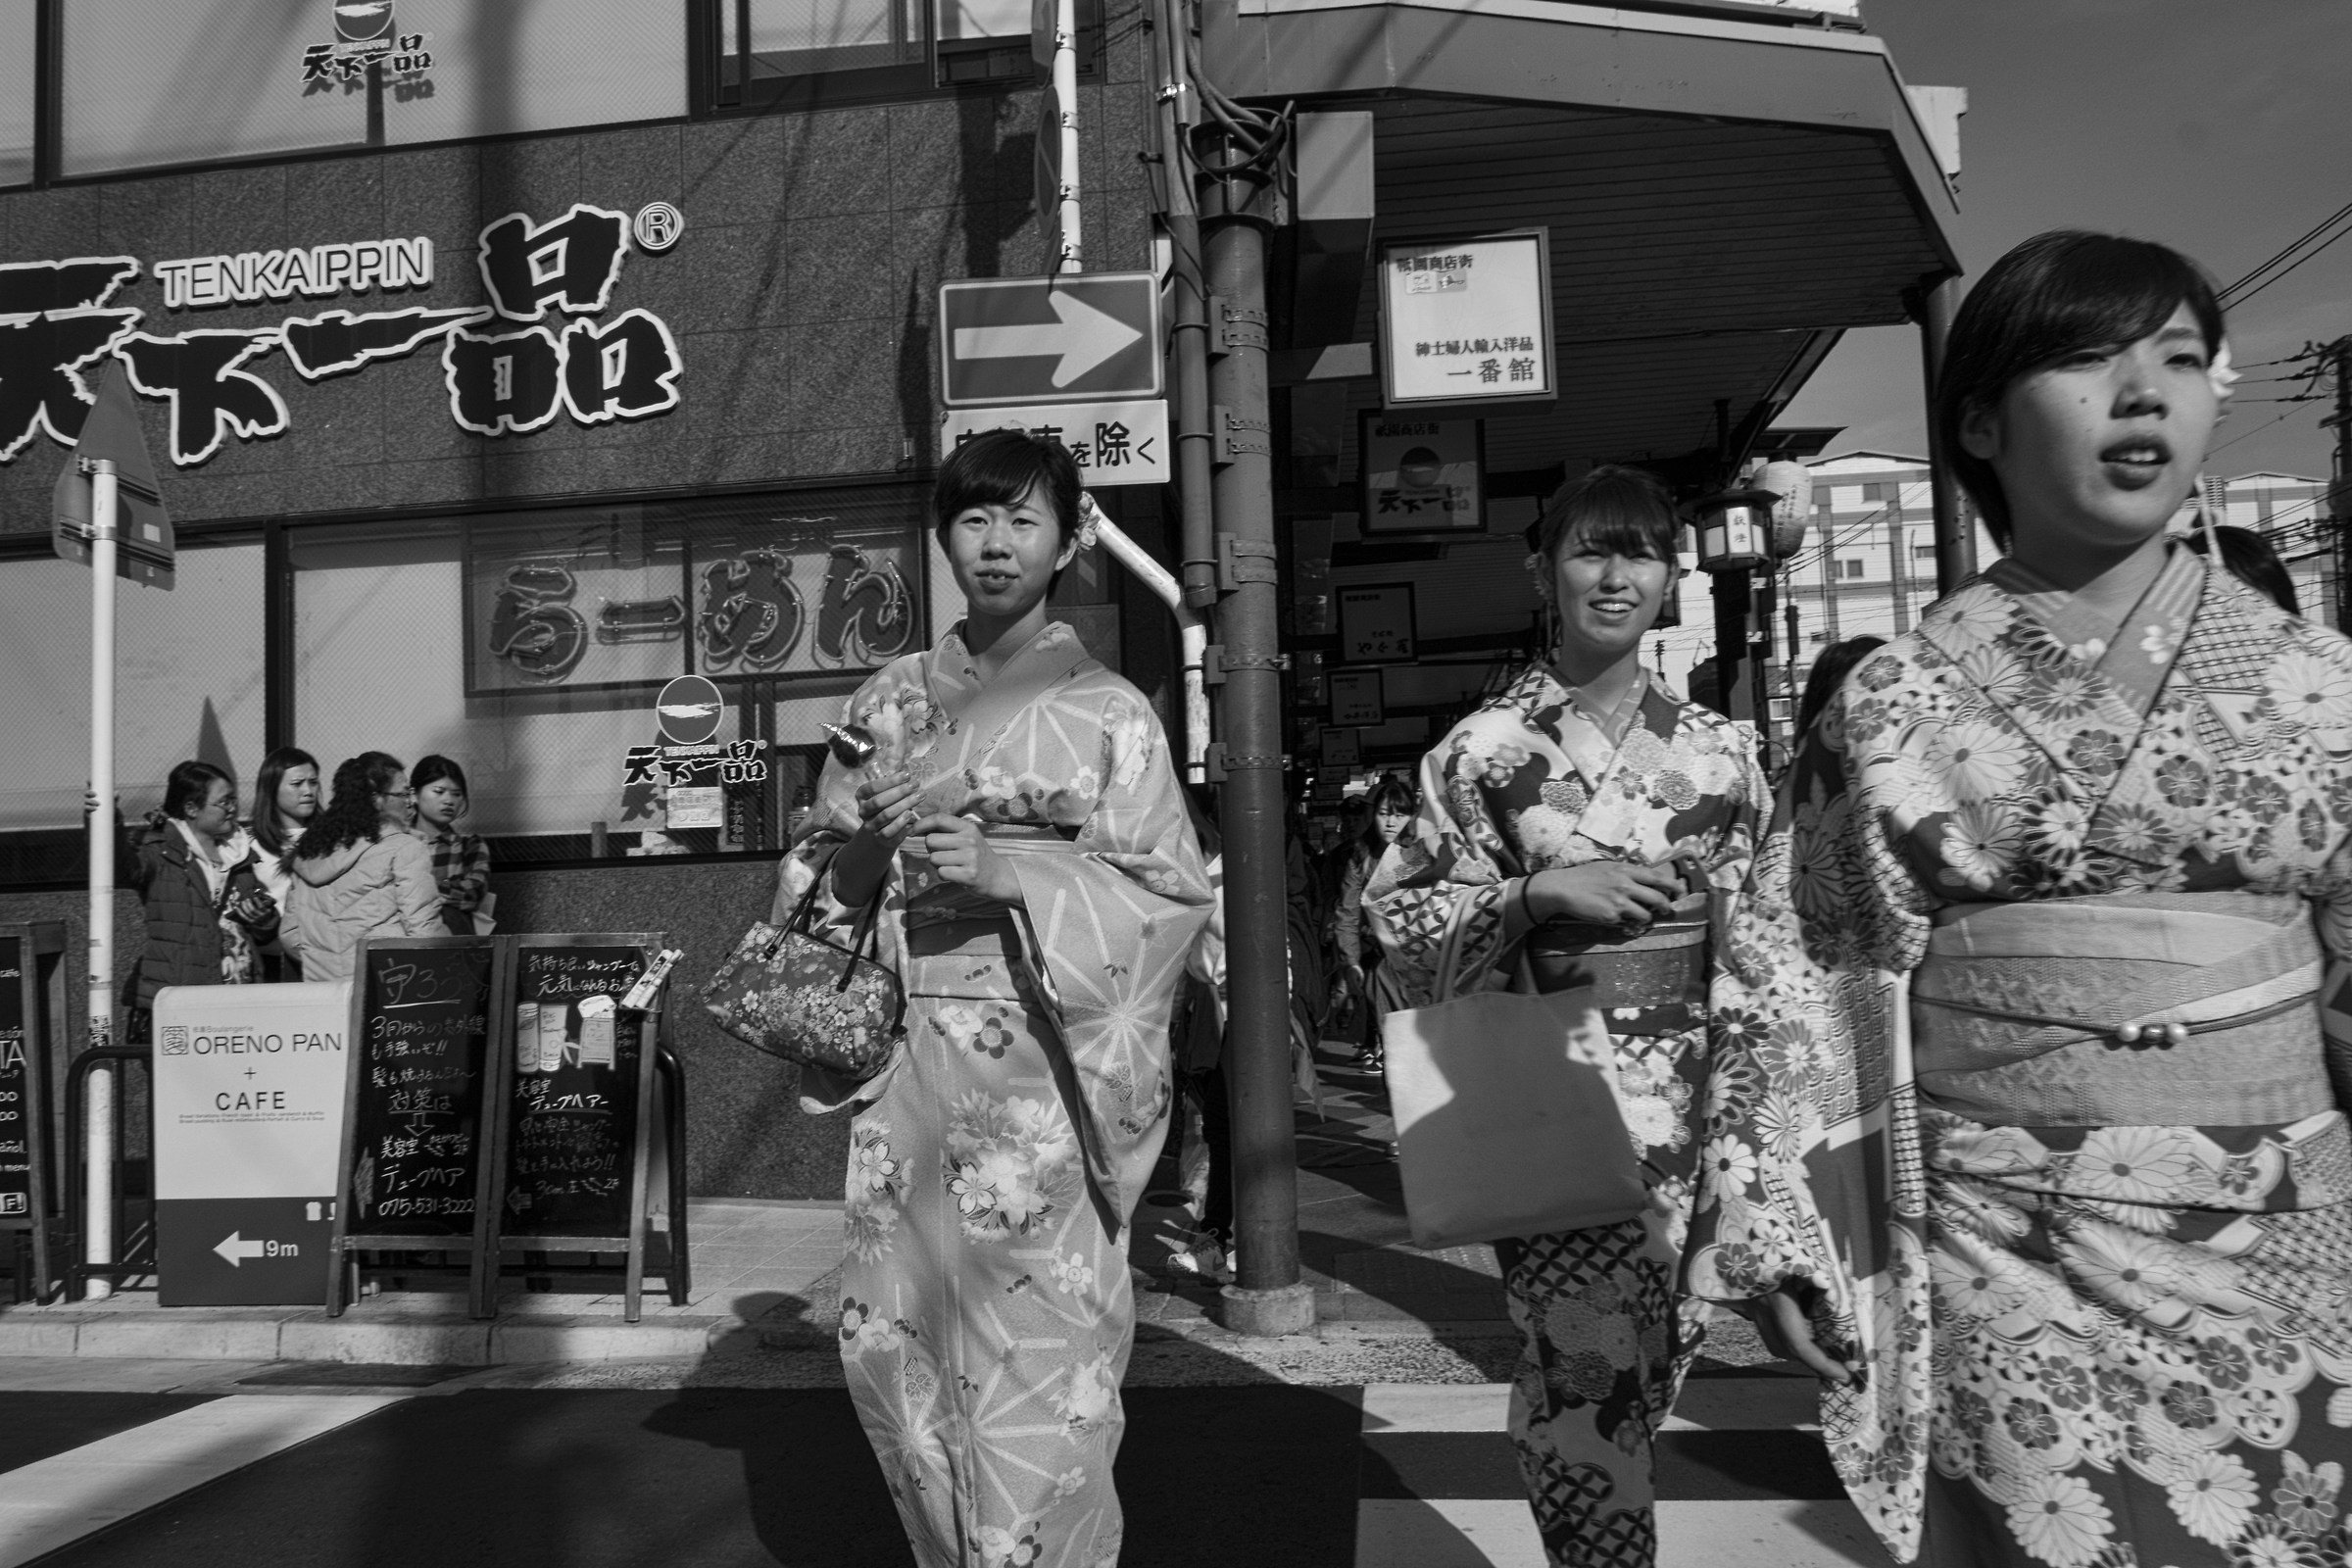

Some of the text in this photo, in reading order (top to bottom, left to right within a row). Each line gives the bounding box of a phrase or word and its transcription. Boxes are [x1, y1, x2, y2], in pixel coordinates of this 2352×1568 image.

[301, 32, 433, 82] 天下一品
[156, 238, 432, 308] TENKAIPPIN
[0, 203, 683, 466] 天下一品
[1415, 336, 1535, 357] 紳士婦人輸入洋品
[956, 420, 1156, 467] を除く
[1378, 486, 1470, 514] 天下一品
[491, 544, 913, 680] らーめん
[622, 739, 768, 787] 天下一品
[194, 1034, 283, 1054] ORENO
[292, 1033, 342, 1053] PAN
[216, 1091, 286, 1110] CAFE
[266, 1239, 299, 1257] 9m
